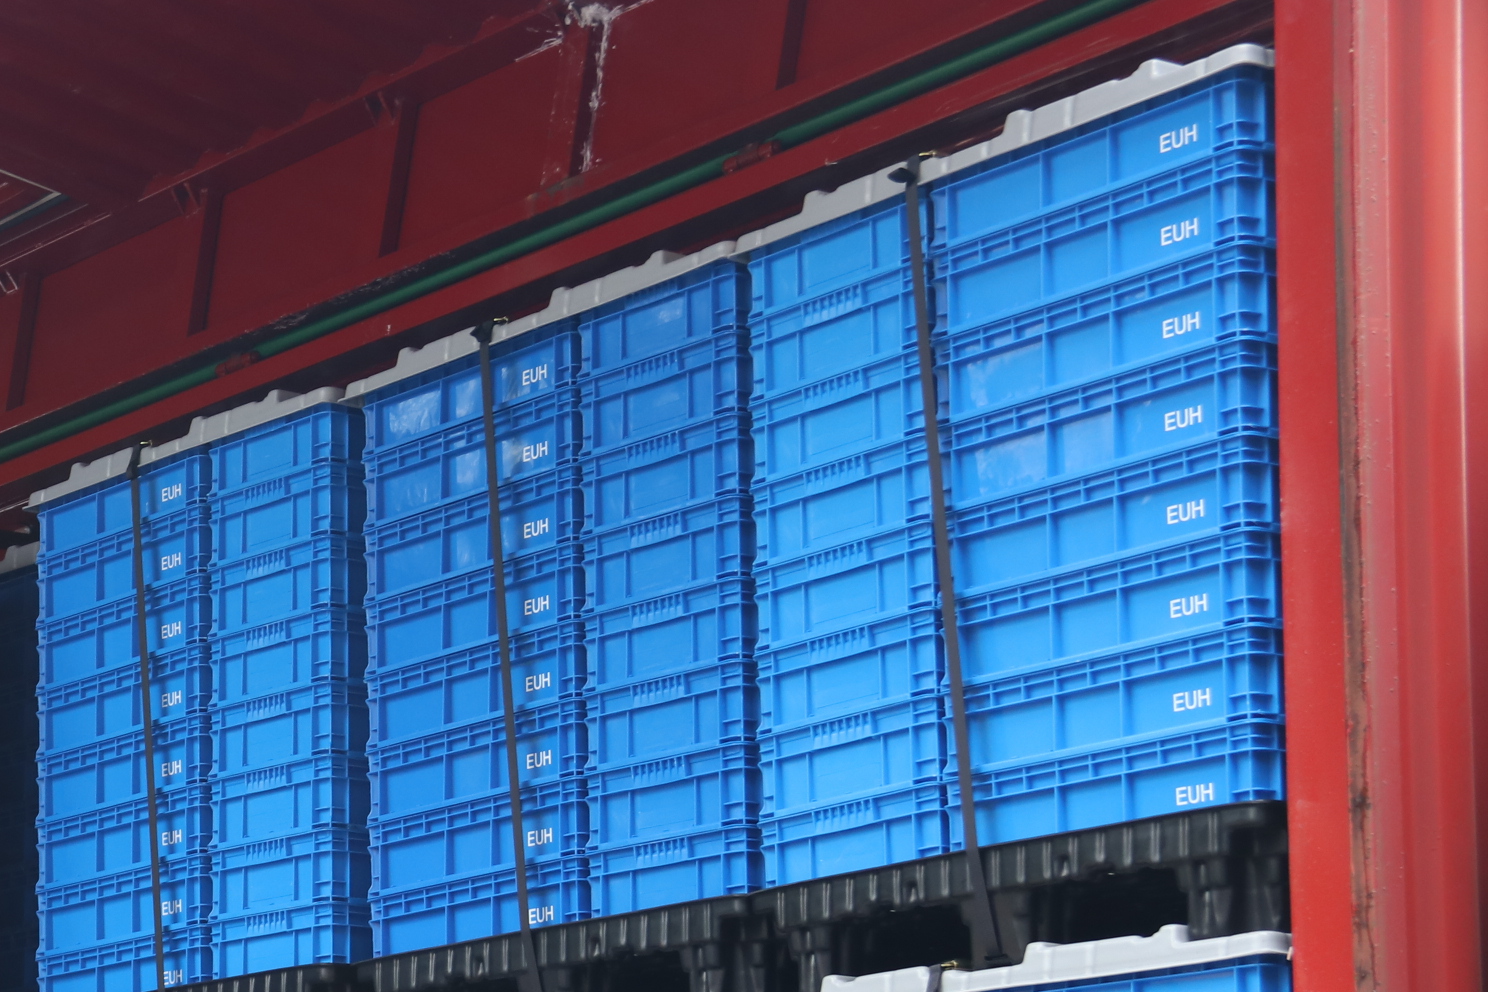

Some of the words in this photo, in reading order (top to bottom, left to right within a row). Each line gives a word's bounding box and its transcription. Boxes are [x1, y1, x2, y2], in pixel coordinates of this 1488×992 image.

[1160, 124, 1197, 153] EUH
[1161, 218, 1198, 246] EUH
[1162, 312, 1200, 338] EUH
[522, 364, 547, 386] EUH
[1164, 405, 1202, 431] EUH
[523, 441, 548, 462] EUH
[162, 483, 181, 502] EUH
[1167, 499, 1205, 524] EUH
[524, 518, 548, 538] EUH
[162, 552, 181, 570] EUH
[525, 595, 549, 615] EUH
[1170, 594, 1208, 618] EUH
[162, 621, 181, 639] EUH
[526, 672, 550, 692] EUH
[162, 690, 181, 707] EUH
[1173, 688, 1211, 712] EUH
[162, 760, 182, 777] EUH
[527, 750, 551, 769] EUH
[1176, 783, 1214, 806] EUH
[162, 829, 182, 846] EUH
[528, 828, 552, 847] EUH
[162, 899, 182, 916] EUH
[529, 906, 553, 924] EUH
[163, 969, 182, 986] EUH
